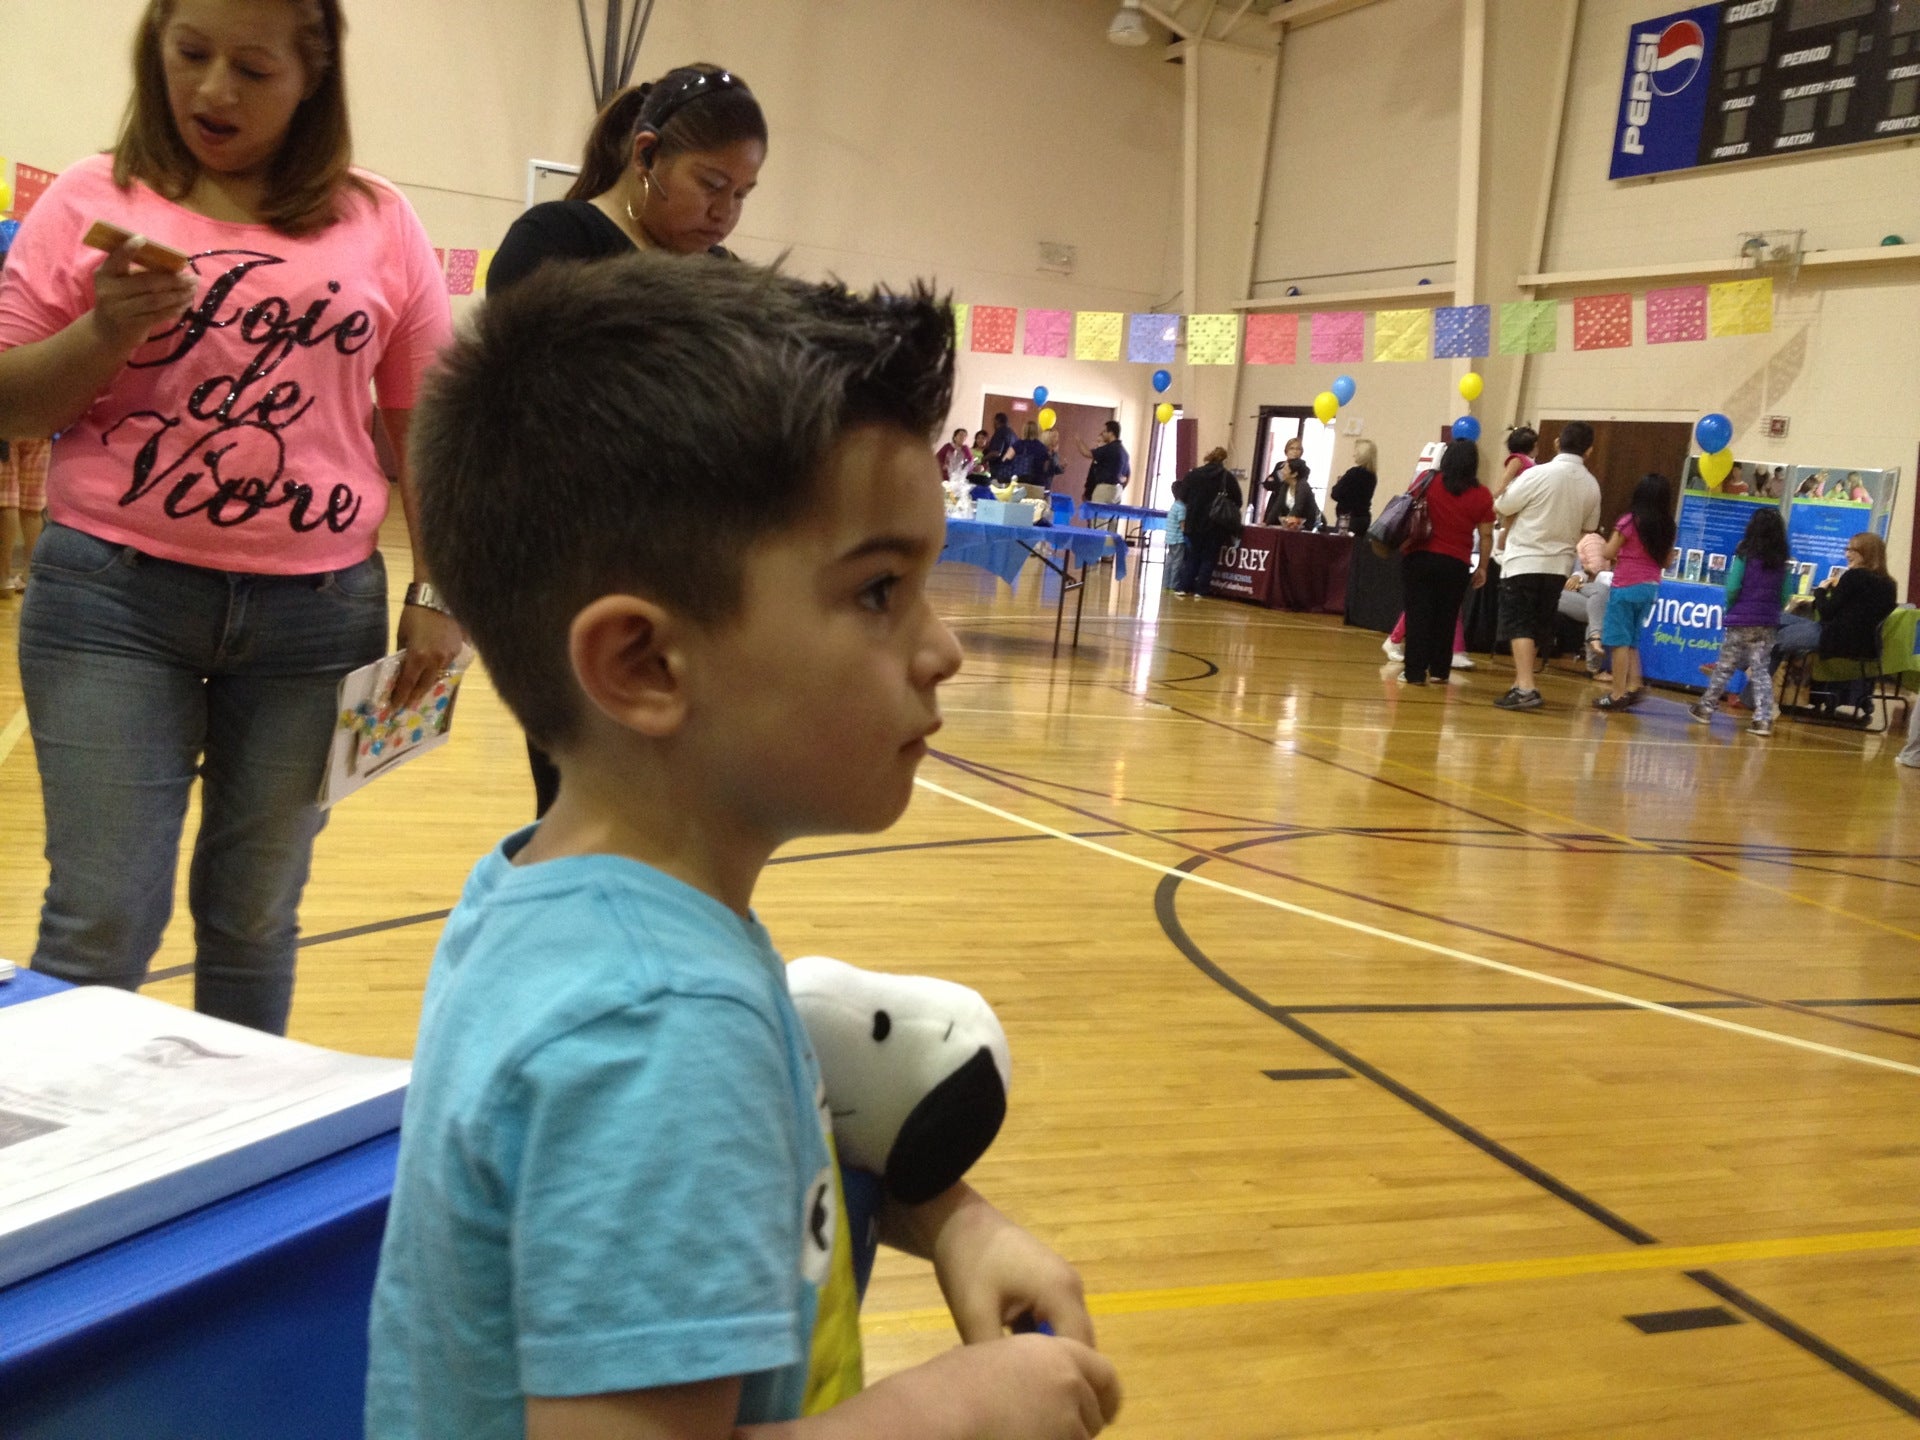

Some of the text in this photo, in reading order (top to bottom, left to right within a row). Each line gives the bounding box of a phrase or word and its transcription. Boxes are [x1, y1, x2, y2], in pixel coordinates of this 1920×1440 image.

[1778, 45, 1832, 69] PERIOD
[1888, 64, 1920, 80] FOUL
[1622, 32, 1662, 155] PEPSI
[1722, 95, 1756, 112] FOULS
[1712, 143, 1749, 159] POINTS
[1775, 132, 1814, 148] MATCH
[127, 249, 375, 368] Joie
[187, 331, 315, 430] de
[1238, 547, 1270, 571] REY
